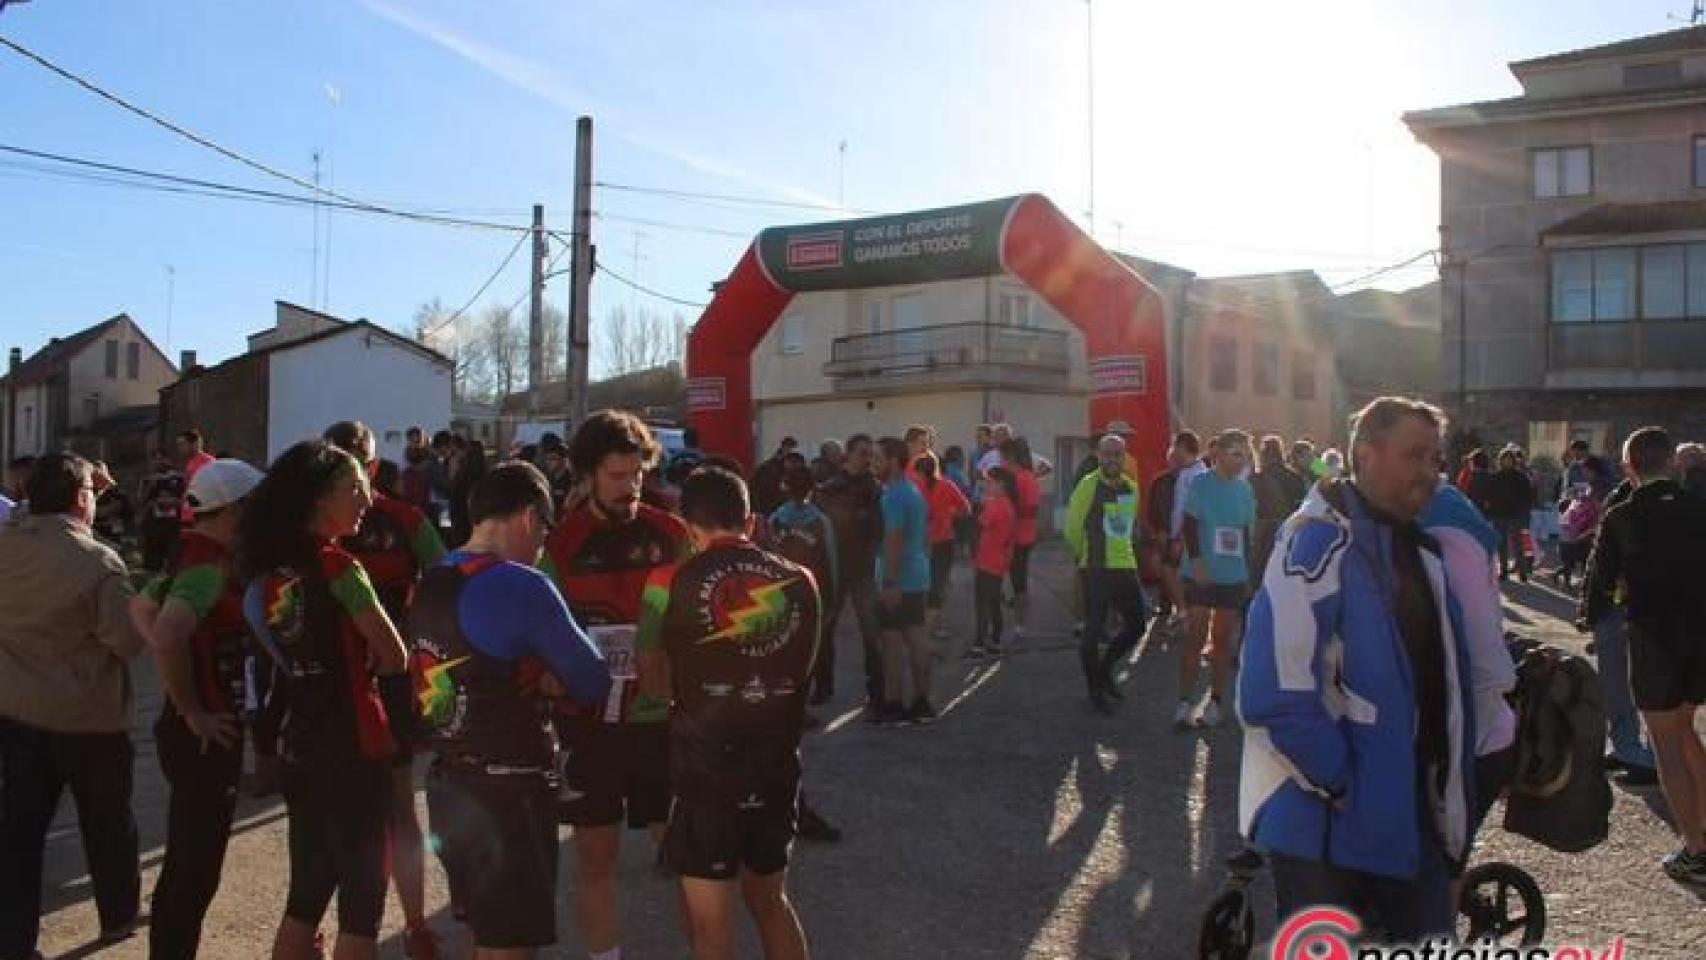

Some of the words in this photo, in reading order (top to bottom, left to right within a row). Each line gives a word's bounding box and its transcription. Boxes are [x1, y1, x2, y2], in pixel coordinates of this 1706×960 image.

[854, 226, 883, 241] CON
[886, 223, 900, 238] EL
[906, 214, 971, 236] DEPORTE
[854, 241, 919, 263] GANAMOS
[921, 234, 970, 253] TODOS
